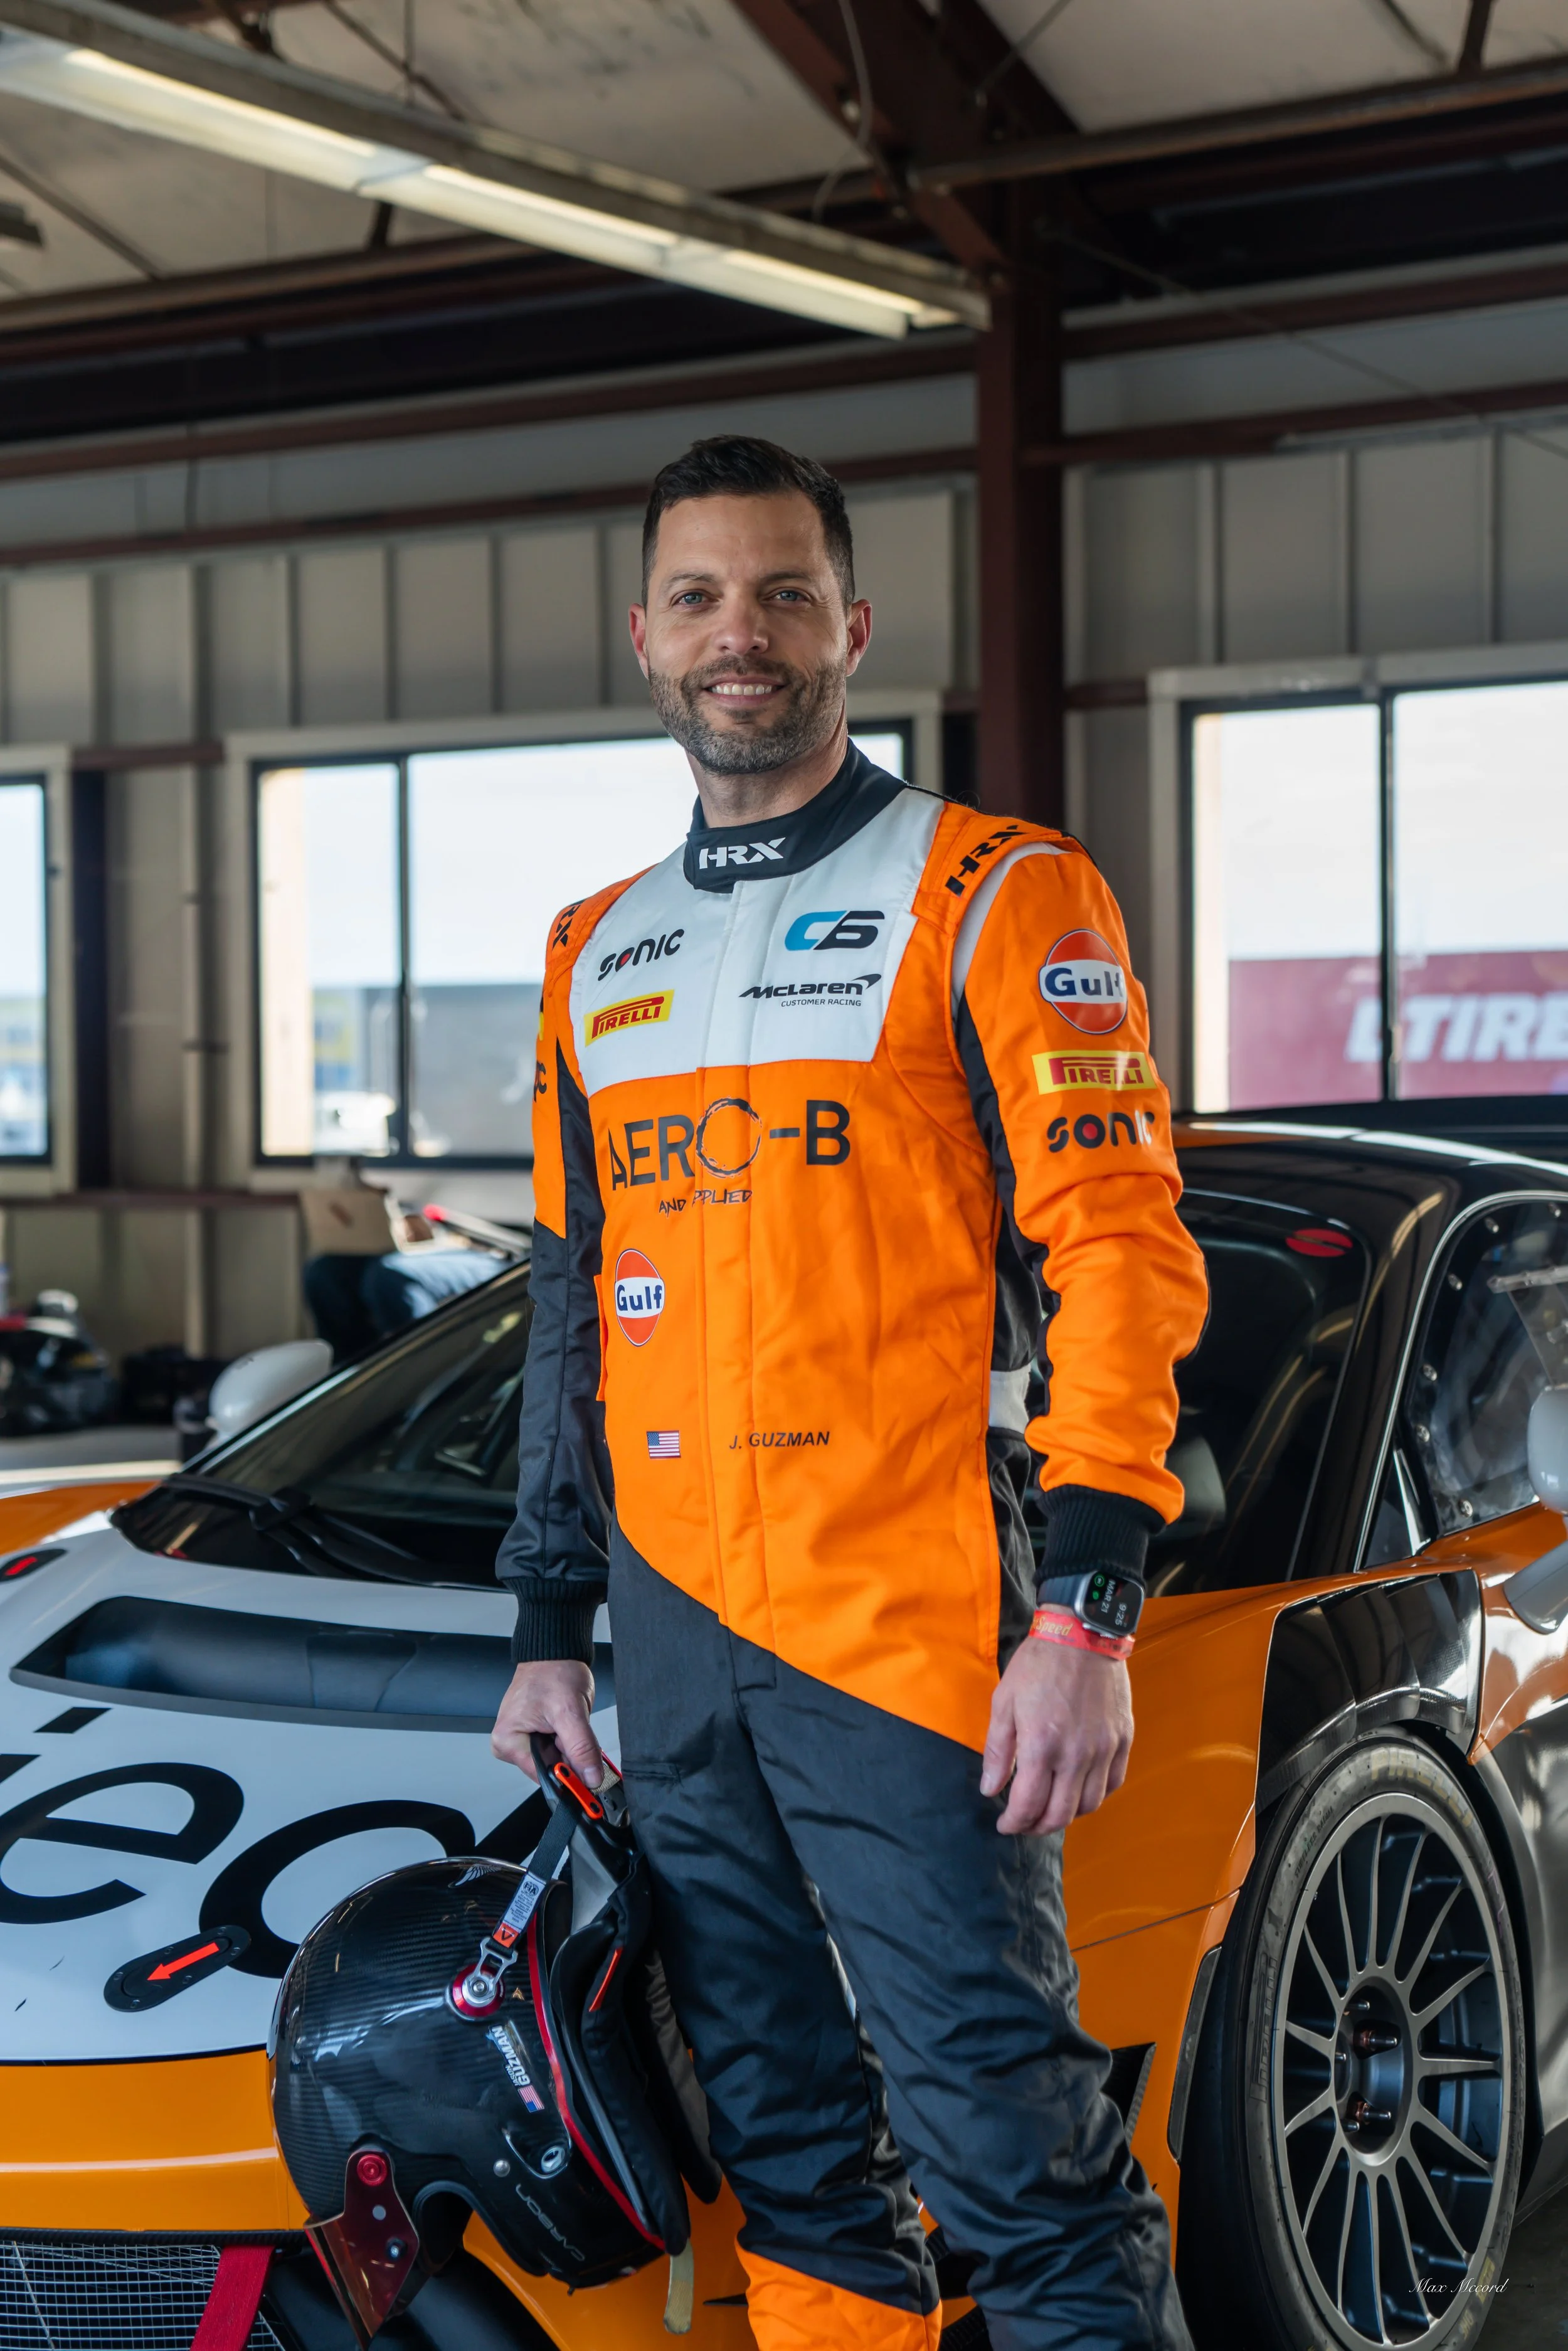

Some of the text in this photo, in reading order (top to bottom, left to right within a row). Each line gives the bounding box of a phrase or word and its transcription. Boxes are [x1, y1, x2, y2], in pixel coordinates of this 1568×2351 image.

[699, 837, 786, 869] HRX
[945, 825, 1030, 897] HRX
[738, 981, 864, 999] McLaren
[1045, 967, 1125, 997] Gulf
[781, 999, 862, 1007] CUSTOMER RACING
[591, 996, 665, 1039] PIRELLI
[1048, 1056, 1144, 1086] PIRELLI
[659, 1197, 687, 1218] AND
[617, 1284, 662, 1311] Gulf
[729, 1431, 830, 1449] J. GUZMAN
[1104, 1579, 1116, 1601] MAR
[1115, 1603, 1127, 1626] 9:25
[492, 2025, 530, 2086] GUZMAN
[505, 2065, 520, 2086] JASON
